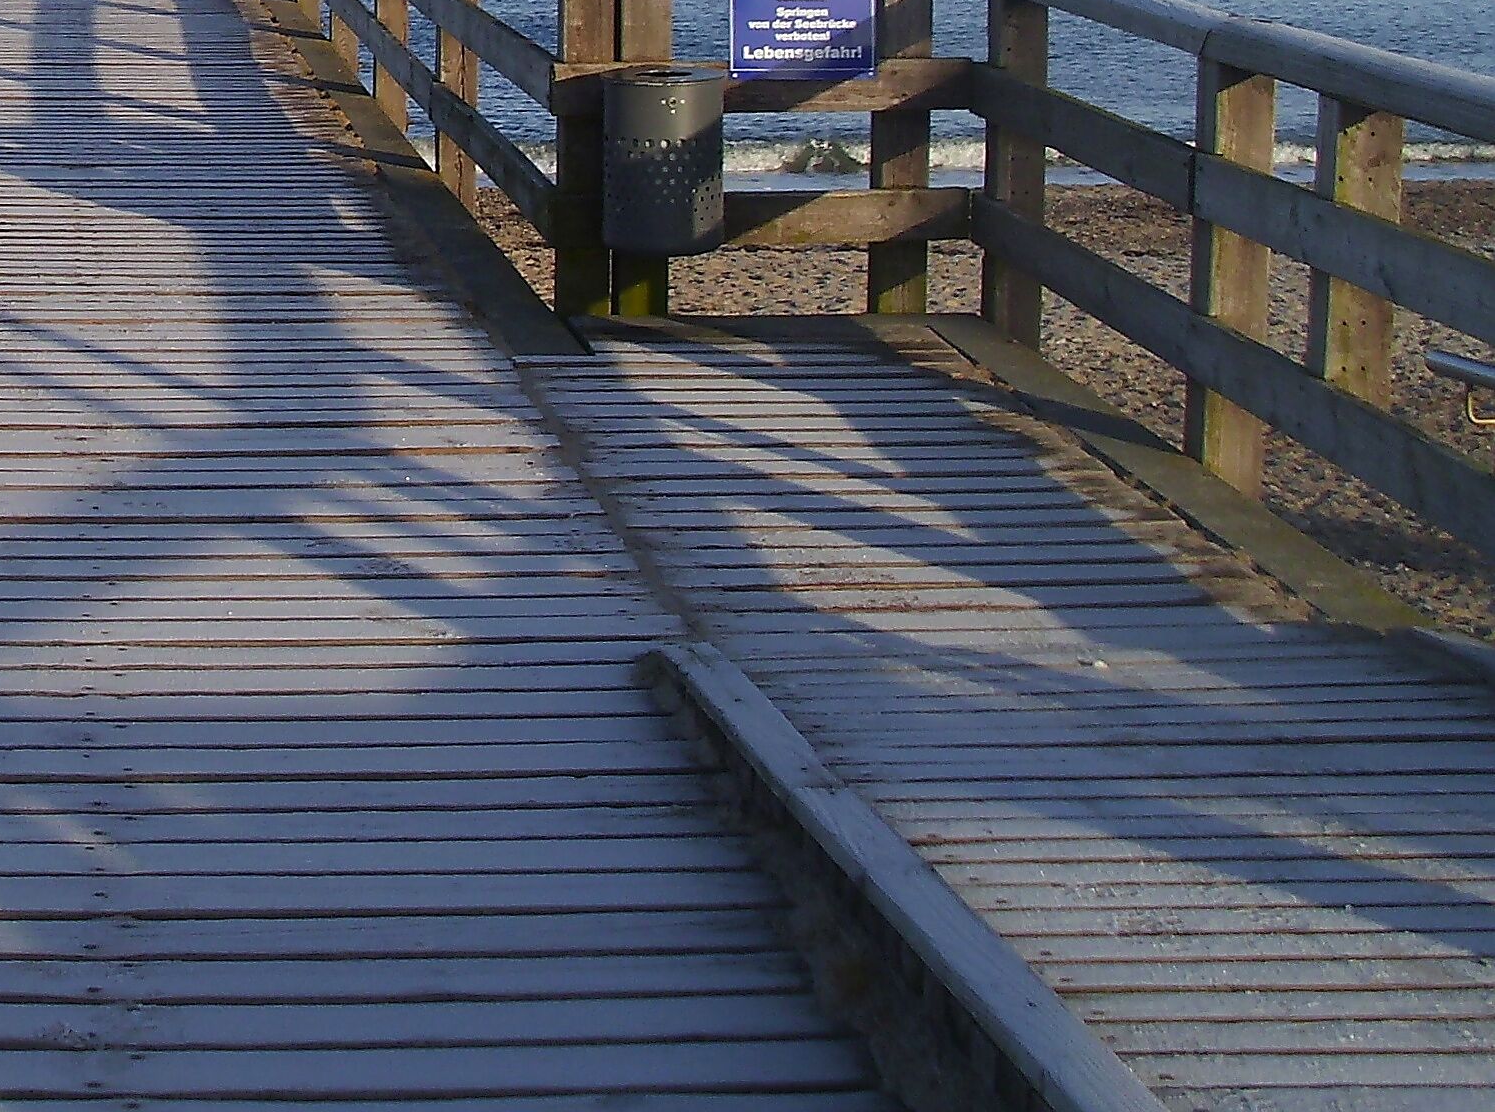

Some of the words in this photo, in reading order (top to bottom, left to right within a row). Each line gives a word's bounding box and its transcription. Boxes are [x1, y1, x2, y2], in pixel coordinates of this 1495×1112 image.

[775, 6, 829, 19] Springen
[748, 20, 770, 29] von
[771, 19, 793, 29] der
[794, 19, 857, 29] Seebrücke
[775, 31, 831, 41] verboten!
[743, 45, 862, 61] Lebensgefahr!
